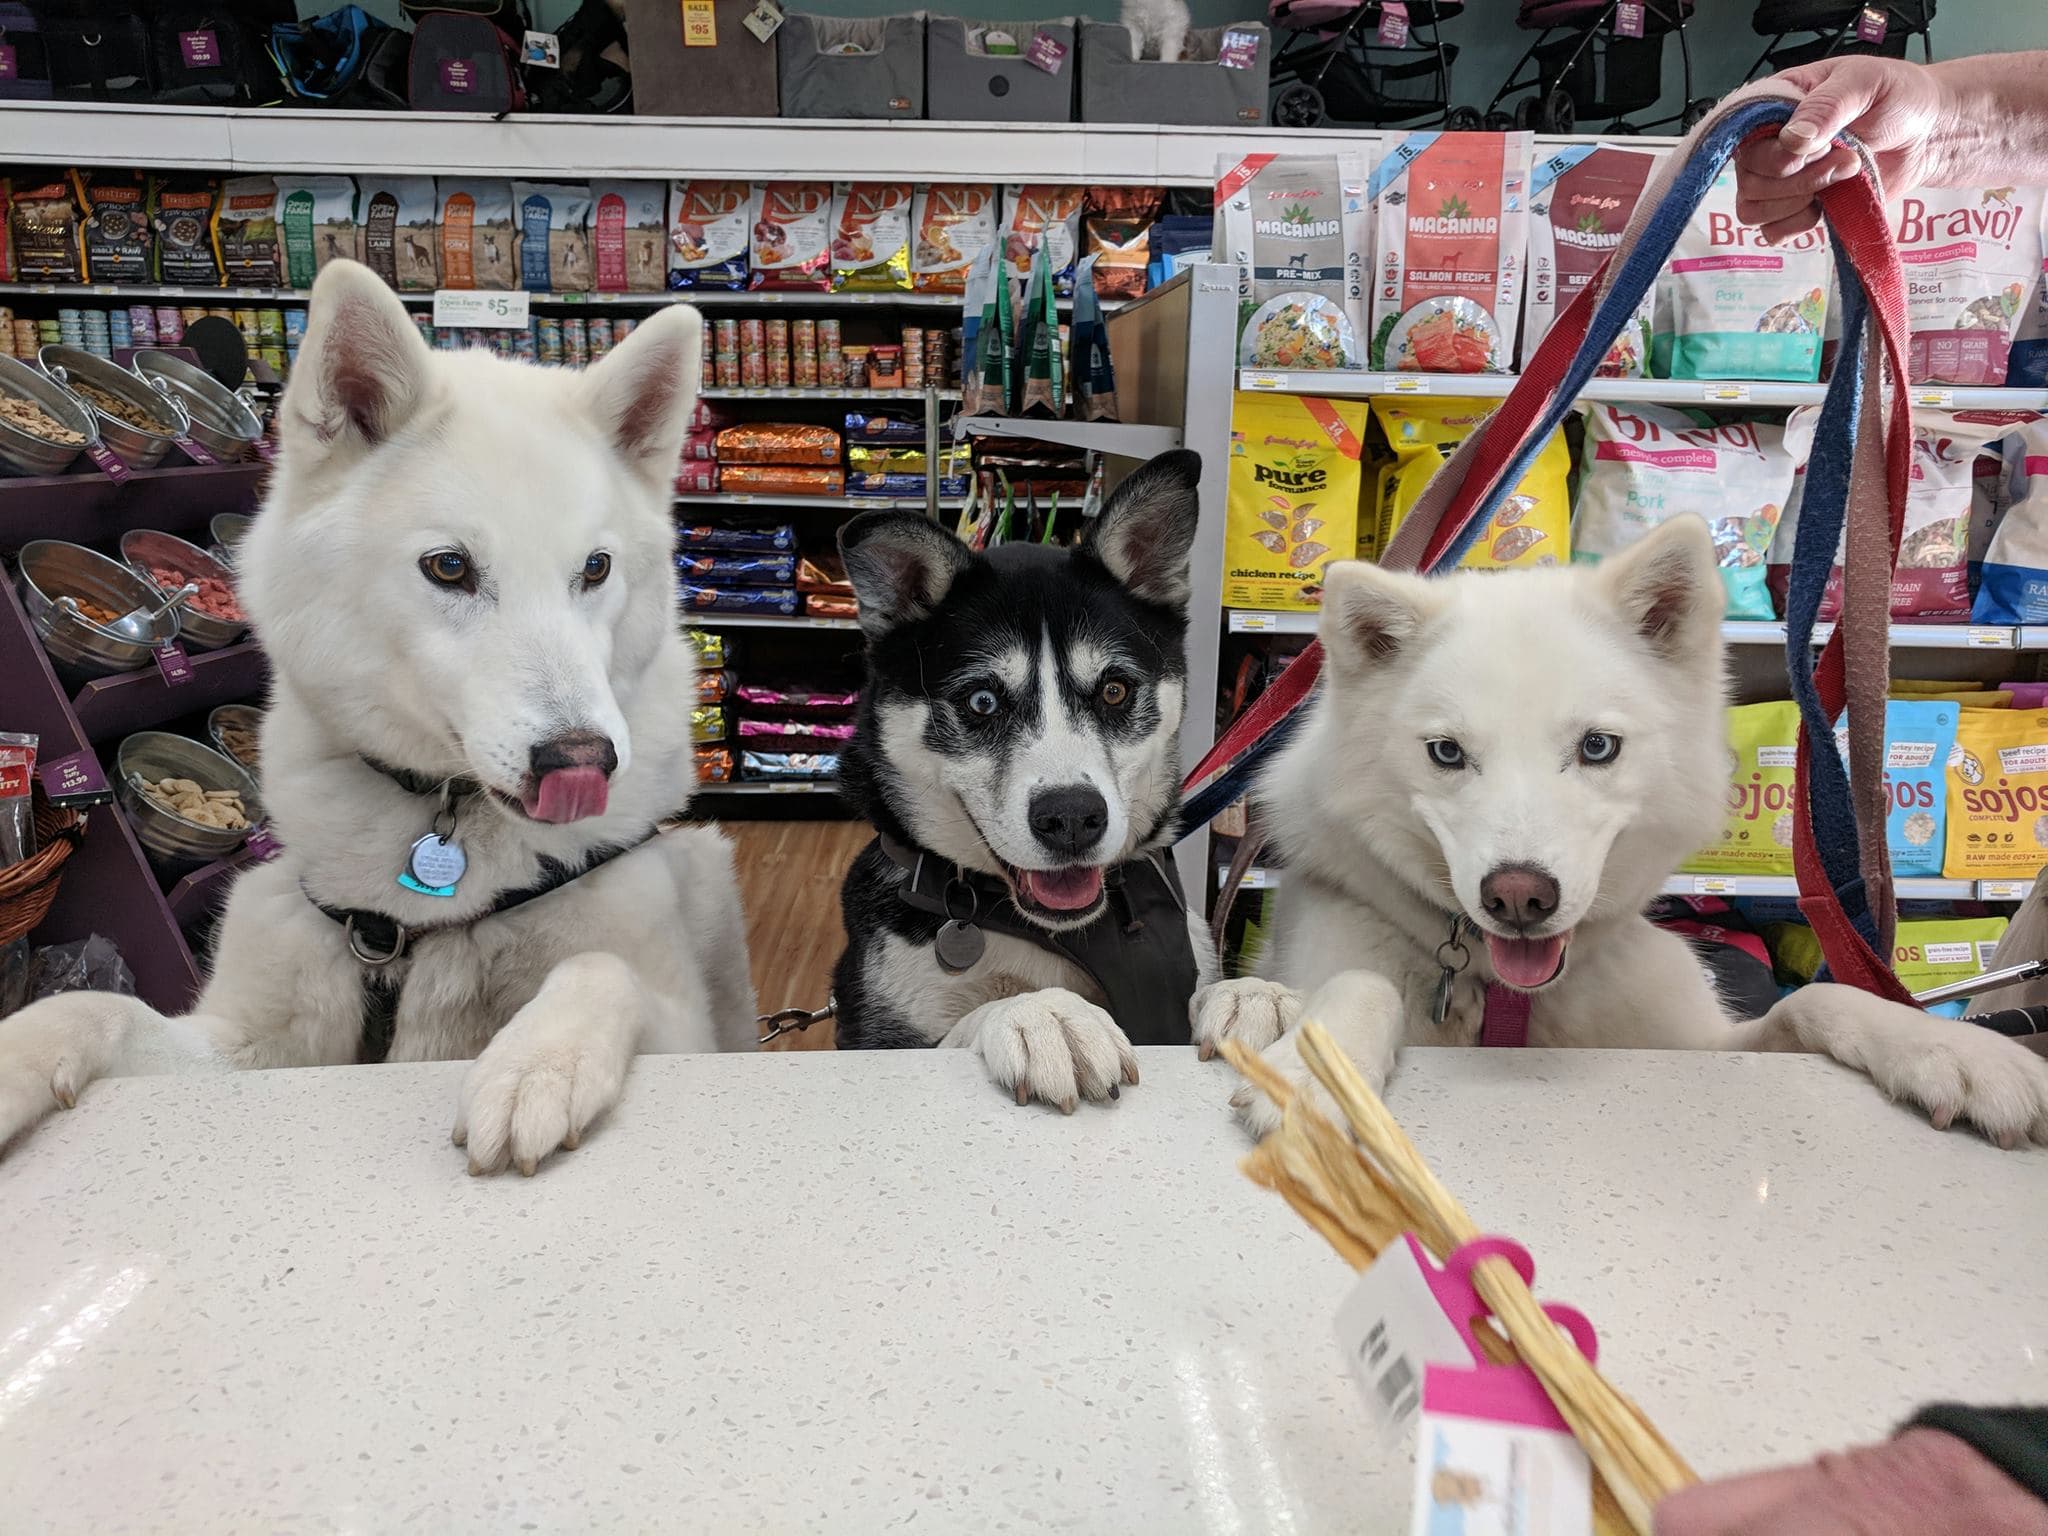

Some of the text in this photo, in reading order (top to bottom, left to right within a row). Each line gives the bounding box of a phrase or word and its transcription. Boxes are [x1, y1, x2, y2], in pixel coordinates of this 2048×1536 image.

[1399, 147, 1413, 160] 15
[1549, 158, 1566, 173] 15
[1236, 166, 1252, 180] 15
[371, 211, 394, 219] FARM
[1255, 220, 1340, 238] MACANNA
[1409, 215, 1498, 234] MACANNA
[1896, 198, 2023, 250] Bravo!
[1553, 225, 1624, 247] MACANN
[369, 240, 391, 248] LAMB
[1934, 245, 1976, 258] complete
[1276, 269, 1321, 280] PRE-MIX
[1409, 271, 1491, 283] SALMON RECIPE
[1909, 282, 1943, 295] Beef
[488, 298, 509, 316] $5
[1937, 340, 1953, 350] NO
[1660, 448, 1714, 465] complete
[1254, 463, 1327, 487] pure
[1268, 481, 1327, 494] formance
[1626, 490, 1665, 510] Pork
[1230, 569, 1316, 581] chicken recipe
[1891, 743, 1935, 752] turkey recipe
[2002, 747, 2047, 758] beef recipe
[2020, 757, 2047, 765] ADULTS
[63, 765, 78, 774] Beef
[61, 775, 88, 789] $13.99
[1963, 777, 2048, 822] sojos
[1968, 814, 2005, 822] COMPLETE
[1720, 848, 1745, 858] made
[1747, 850, 1768, 860] easy
[1988, 852, 2011, 861] made
[2013, 853, 2033, 862] easy
